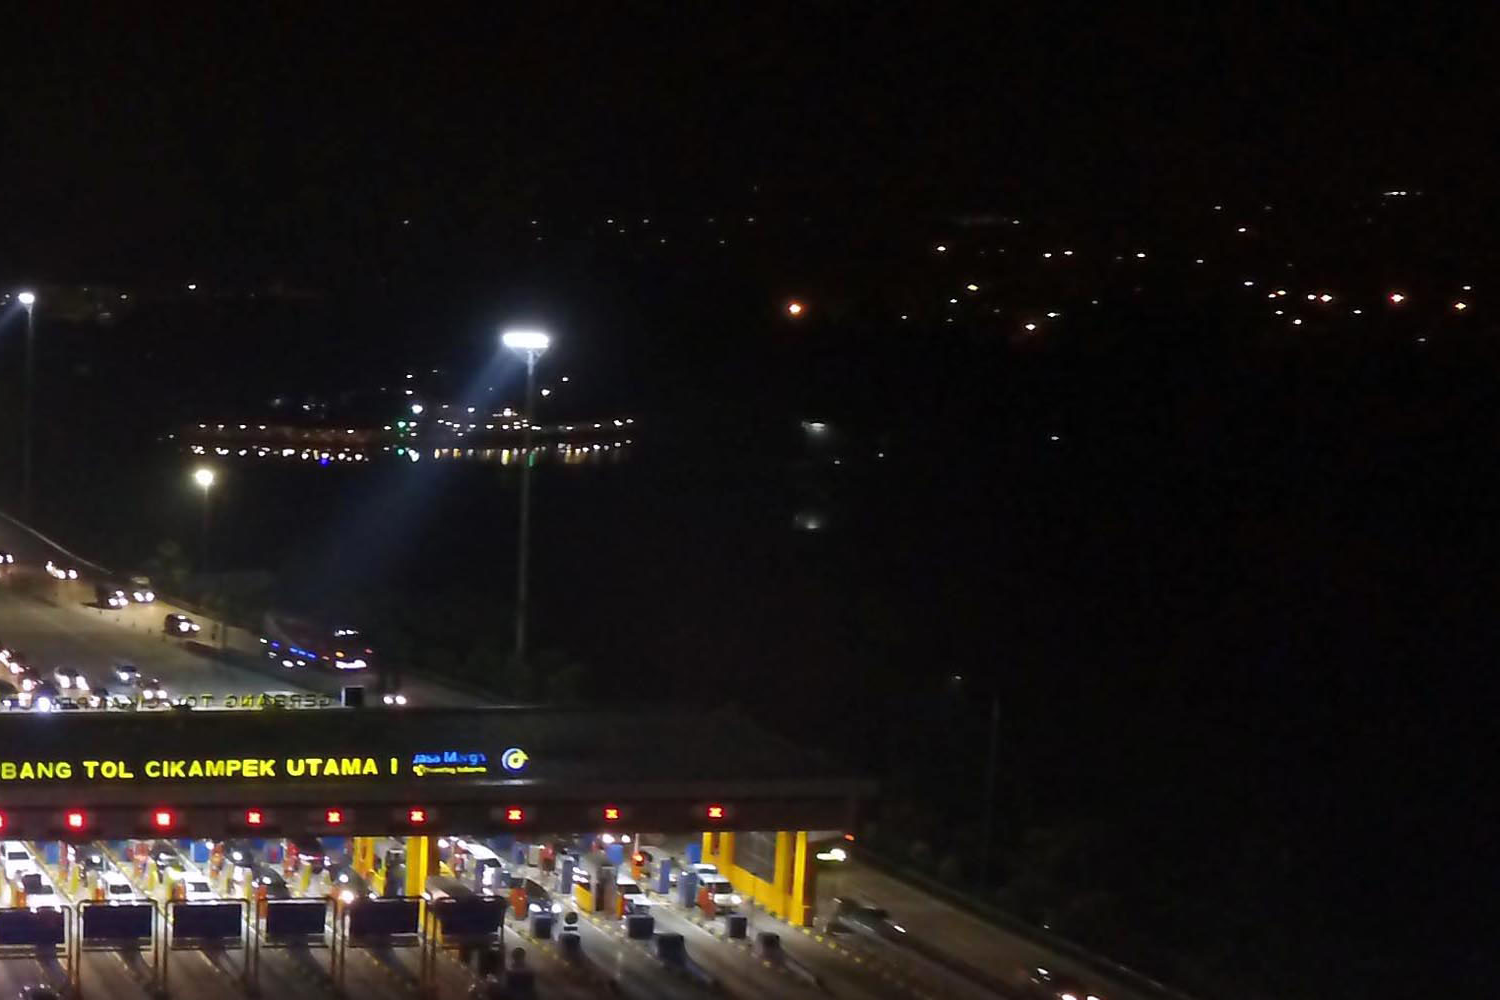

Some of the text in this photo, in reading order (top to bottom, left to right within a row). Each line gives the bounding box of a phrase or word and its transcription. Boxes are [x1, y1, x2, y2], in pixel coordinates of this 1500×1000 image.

[82, 760, 135, 779] TOL
[144, 758, 277, 778] CIKAMPEK
[286, 757, 379, 777] UTAMA
